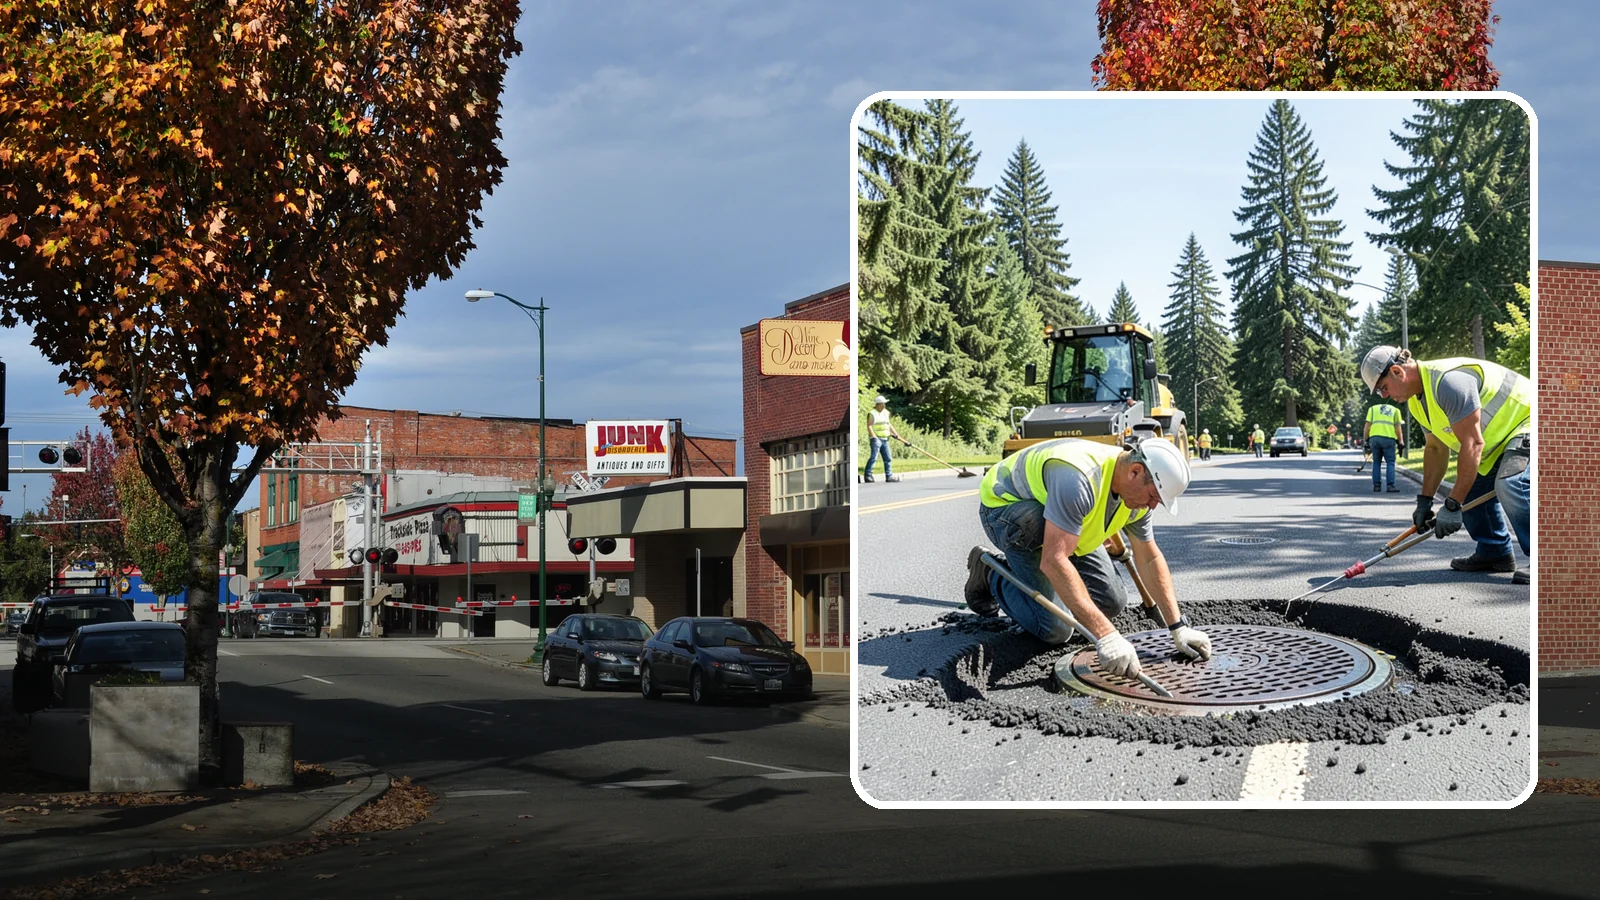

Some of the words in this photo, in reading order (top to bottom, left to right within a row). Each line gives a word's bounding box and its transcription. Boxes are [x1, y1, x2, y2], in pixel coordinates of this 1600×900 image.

[595, 425, 665, 457] JUNK
[607, 446, 646, 454] DISORDERLY
[597, 461, 628, 470] ANTIQUES
[631, 461, 643, 470] AND
[646, 460, 665, 469] GIFTS
[415, 519, 429, 535] Pizza
